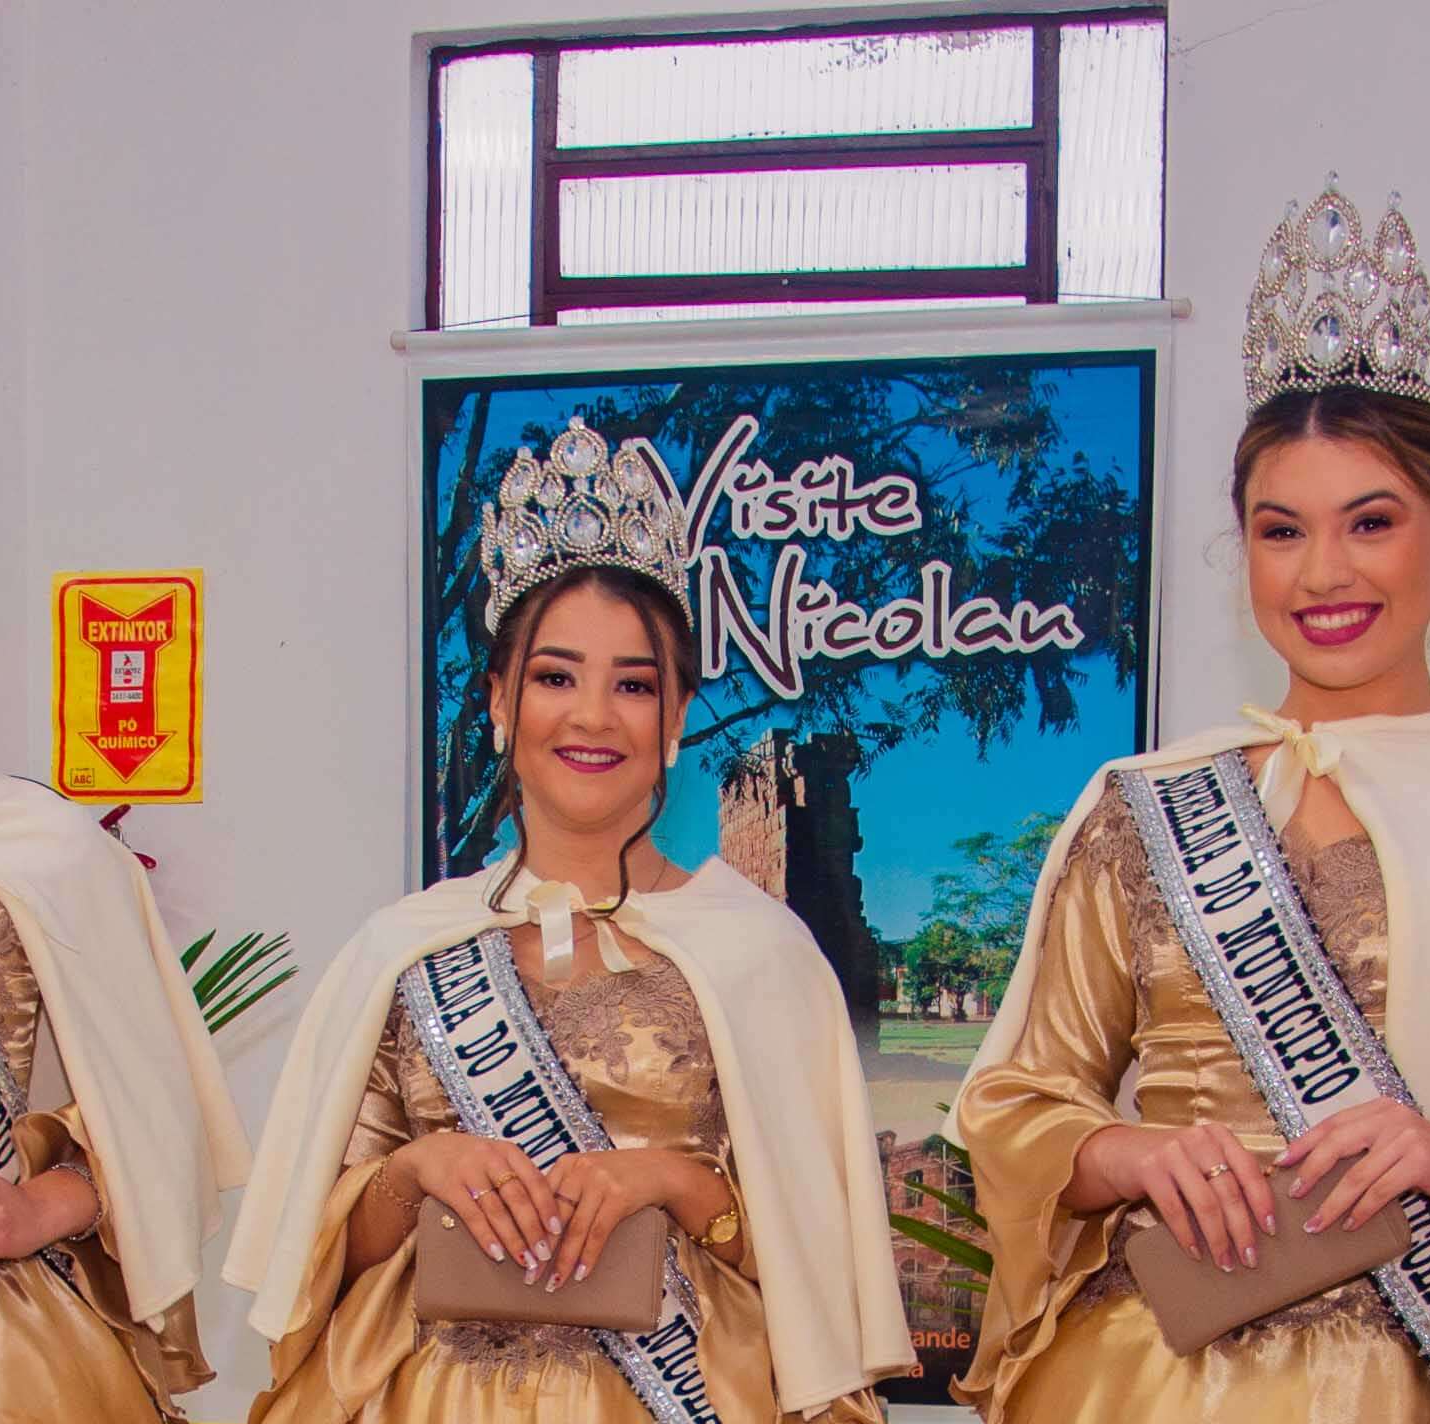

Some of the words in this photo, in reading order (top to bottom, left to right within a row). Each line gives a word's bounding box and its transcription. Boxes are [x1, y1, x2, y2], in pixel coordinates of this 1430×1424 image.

[627, 415, 922, 567] Visite
[88, 620, 168, 642] EXTINTOR
[98, 734, 158, 749] QUÍMICO
[118, 717, 138, 732] PÓ
[1153, 766, 1242, 876] SOBERANA
[1193, 860, 1262, 914] DO
[454, 1020, 518, 1077] DO
